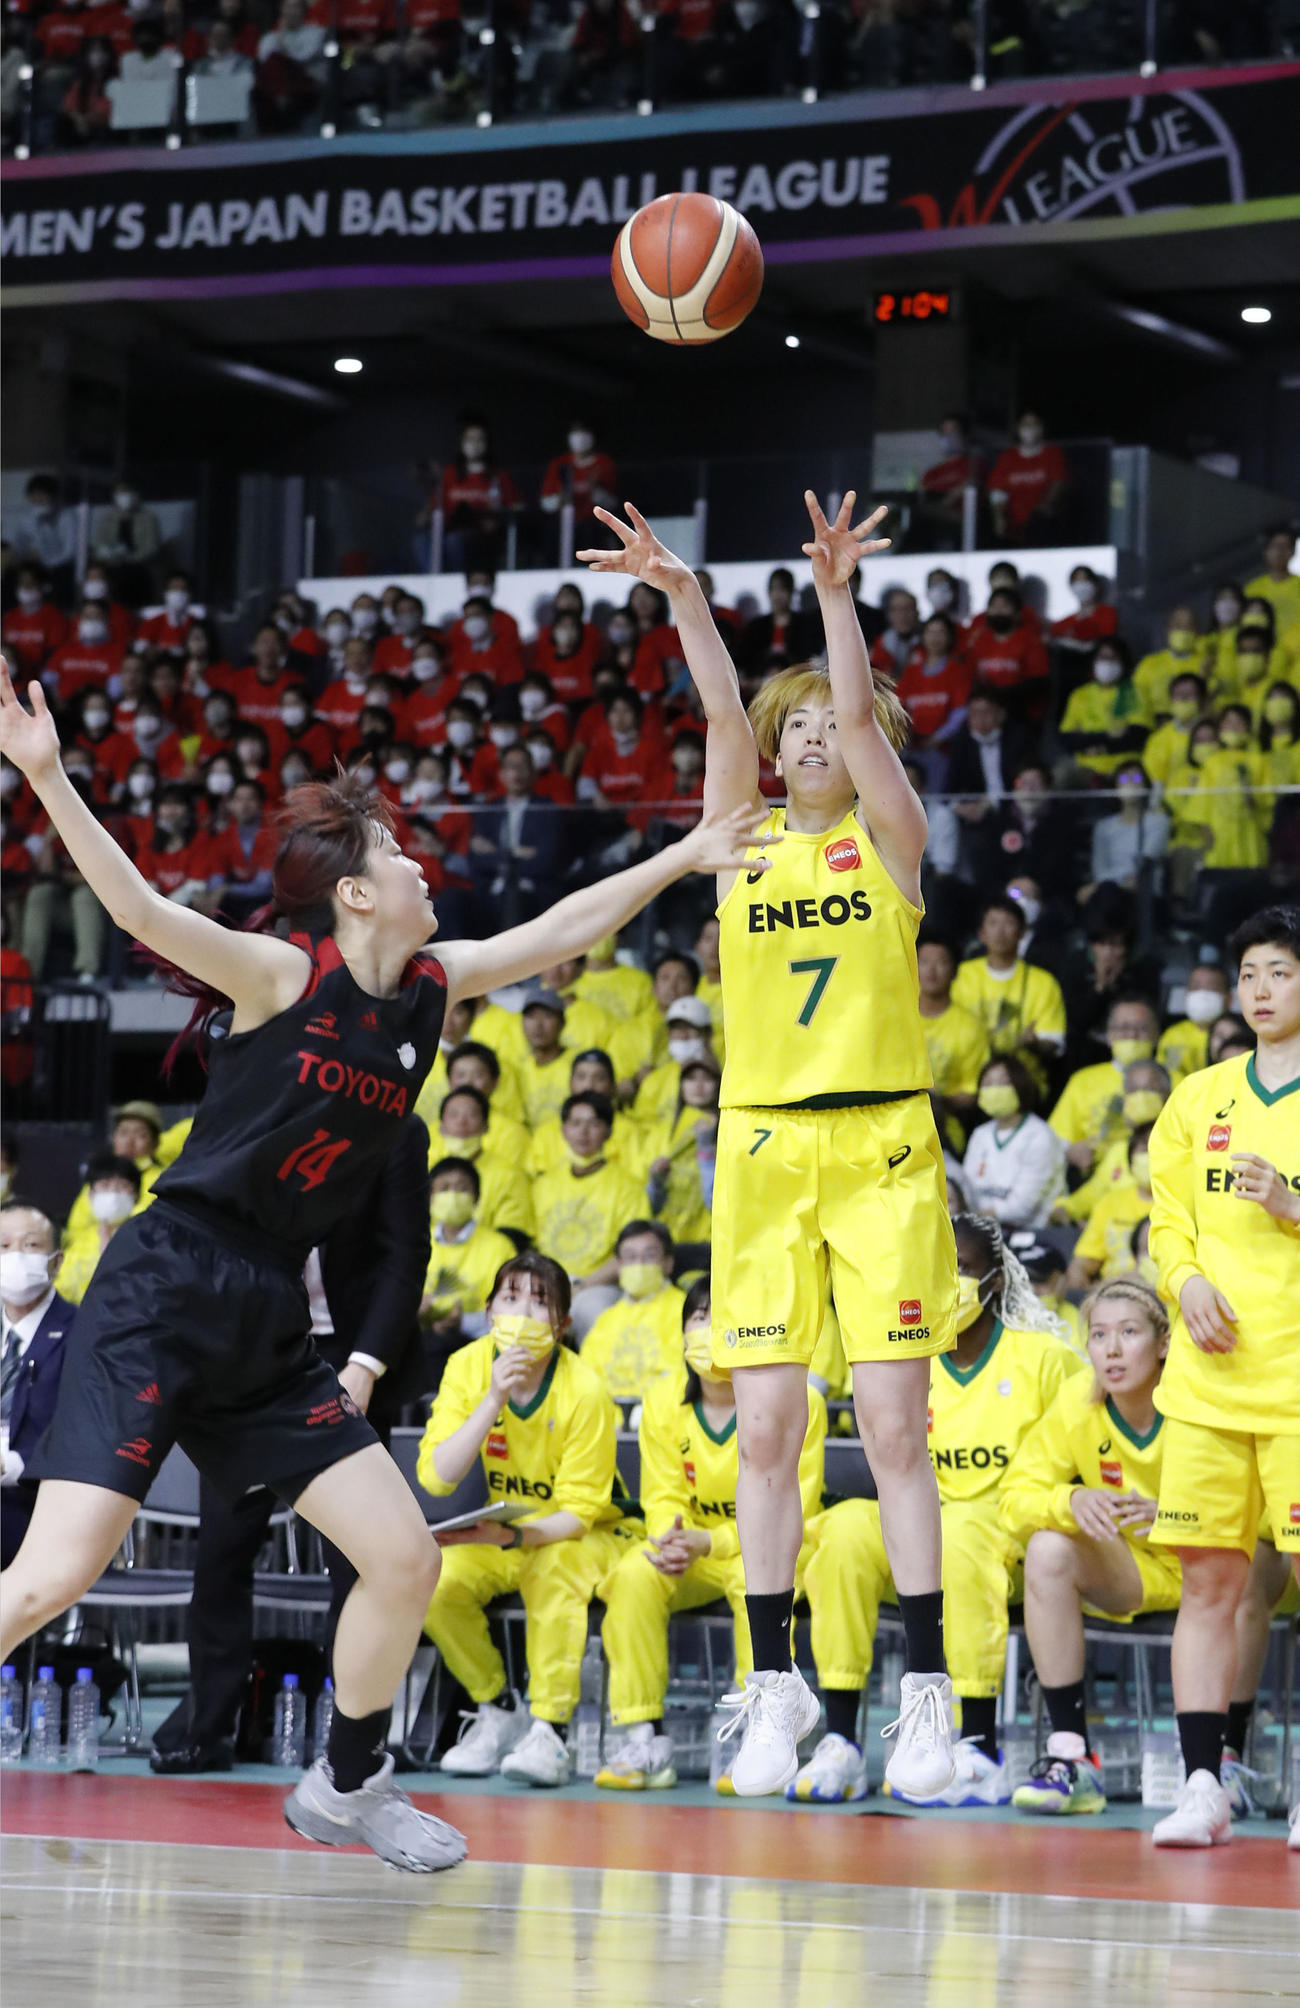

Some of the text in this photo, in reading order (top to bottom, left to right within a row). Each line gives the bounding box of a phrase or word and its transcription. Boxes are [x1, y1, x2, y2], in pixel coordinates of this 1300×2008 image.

[155, 190, 329, 249] JAPAN
[827, 847, 858, 863] ENEOS
[748, 890, 872, 933] ENEOS
[787, 954, 842, 1029] 7
[297, 1050, 408, 1117] TOYOTA
[748, 1129, 773, 1156] 7
[276, 1128, 352, 1192] 14
[738, 1323, 786, 1338] ENEOS
[888, 1327, 930, 1342] ENEOS
[928, 1445, 1009, 1470] NEOS
[489, 1470, 555, 1500] ENEO
[1158, 1510, 1199, 1522] ENEOS
